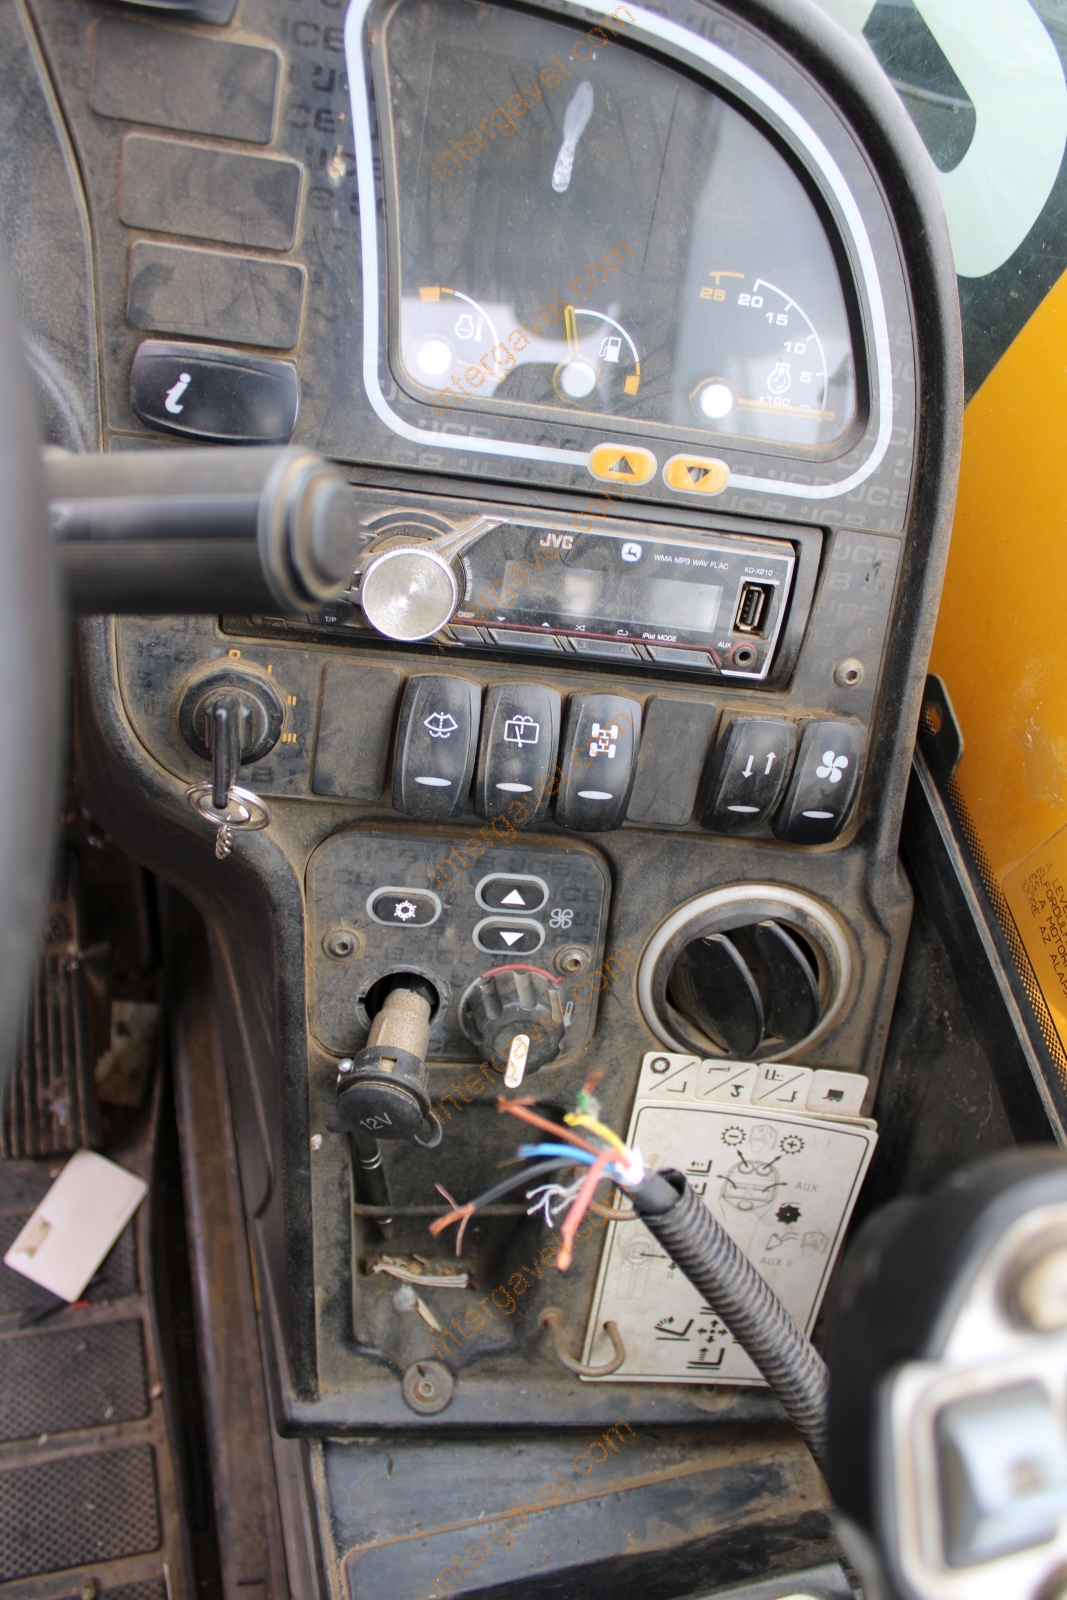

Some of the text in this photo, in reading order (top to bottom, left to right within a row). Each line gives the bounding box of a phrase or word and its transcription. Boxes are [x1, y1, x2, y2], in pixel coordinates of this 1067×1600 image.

[700, 286, 726, 302] 25
[738, 293, 764, 309] 20
[765, 311, 789, 326] 15
[783, 341, 807, 355] 10
[800, 371, 812, 383] 5
[539, 533, 574, 549] JVC
[654, 554, 729, 571] WMA MP3 WAV FLAC
[744, 566, 773, 577] KD-X210
[642, 632, 677, 643] iPod MODE
[717, 641, 732, 649] AUX
[1051, 878, 1067, 919] LEVE
[1038, 900, 1047, 910] A
[1046, 916, 1067, 968] MOTOR
[1038, 926, 1052, 946] AZ
[360, 1112, 392, 1131] 12V
[794, 1181, 820, 1193] AUX
[759, 1256, 784, 1267] AUX
